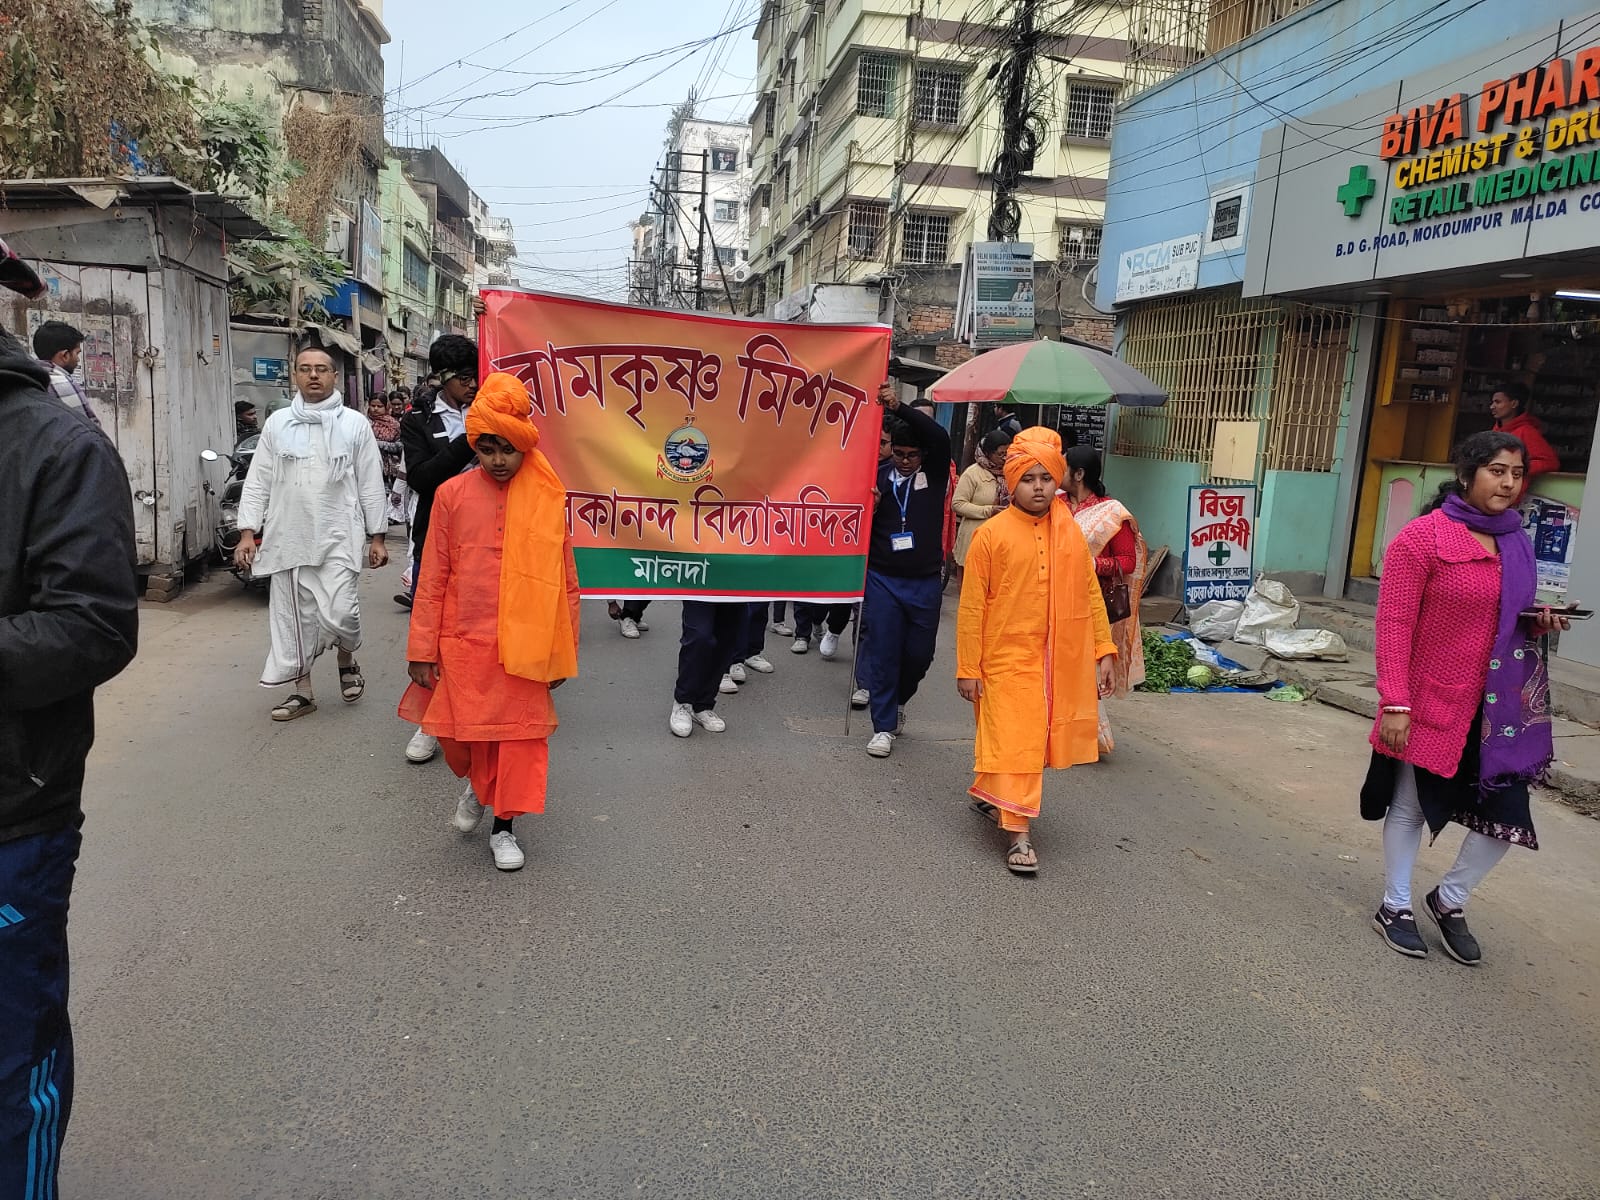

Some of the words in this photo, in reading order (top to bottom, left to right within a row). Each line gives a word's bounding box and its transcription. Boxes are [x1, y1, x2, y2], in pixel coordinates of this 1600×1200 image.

[1380, 93, 1467, 161] BIVA
[1394, 132, 1510, 189] CHEMIST
[1513, 125, 1535, 160] &
[1389, 183, 1466, 225] RETAIL
[1412, 211, 1503, 243] MOKDUMPUR
[1510, 198, 1567, 225] MALDA
[1132, 245, 1171, 272] RCM
[1171, 242, 1185, 258] SUB
[1185, 240, 1198, 254] PUC
[490, 340, 723, 431] রামকৃষ্ণ
[736, 333, 868, 450] মিশন
[689, 484, 865, 548] বিদ্যামন্দির
[1199, 489, 1246, 517] বিভা
[630, 555, 711, 586] মালদা
